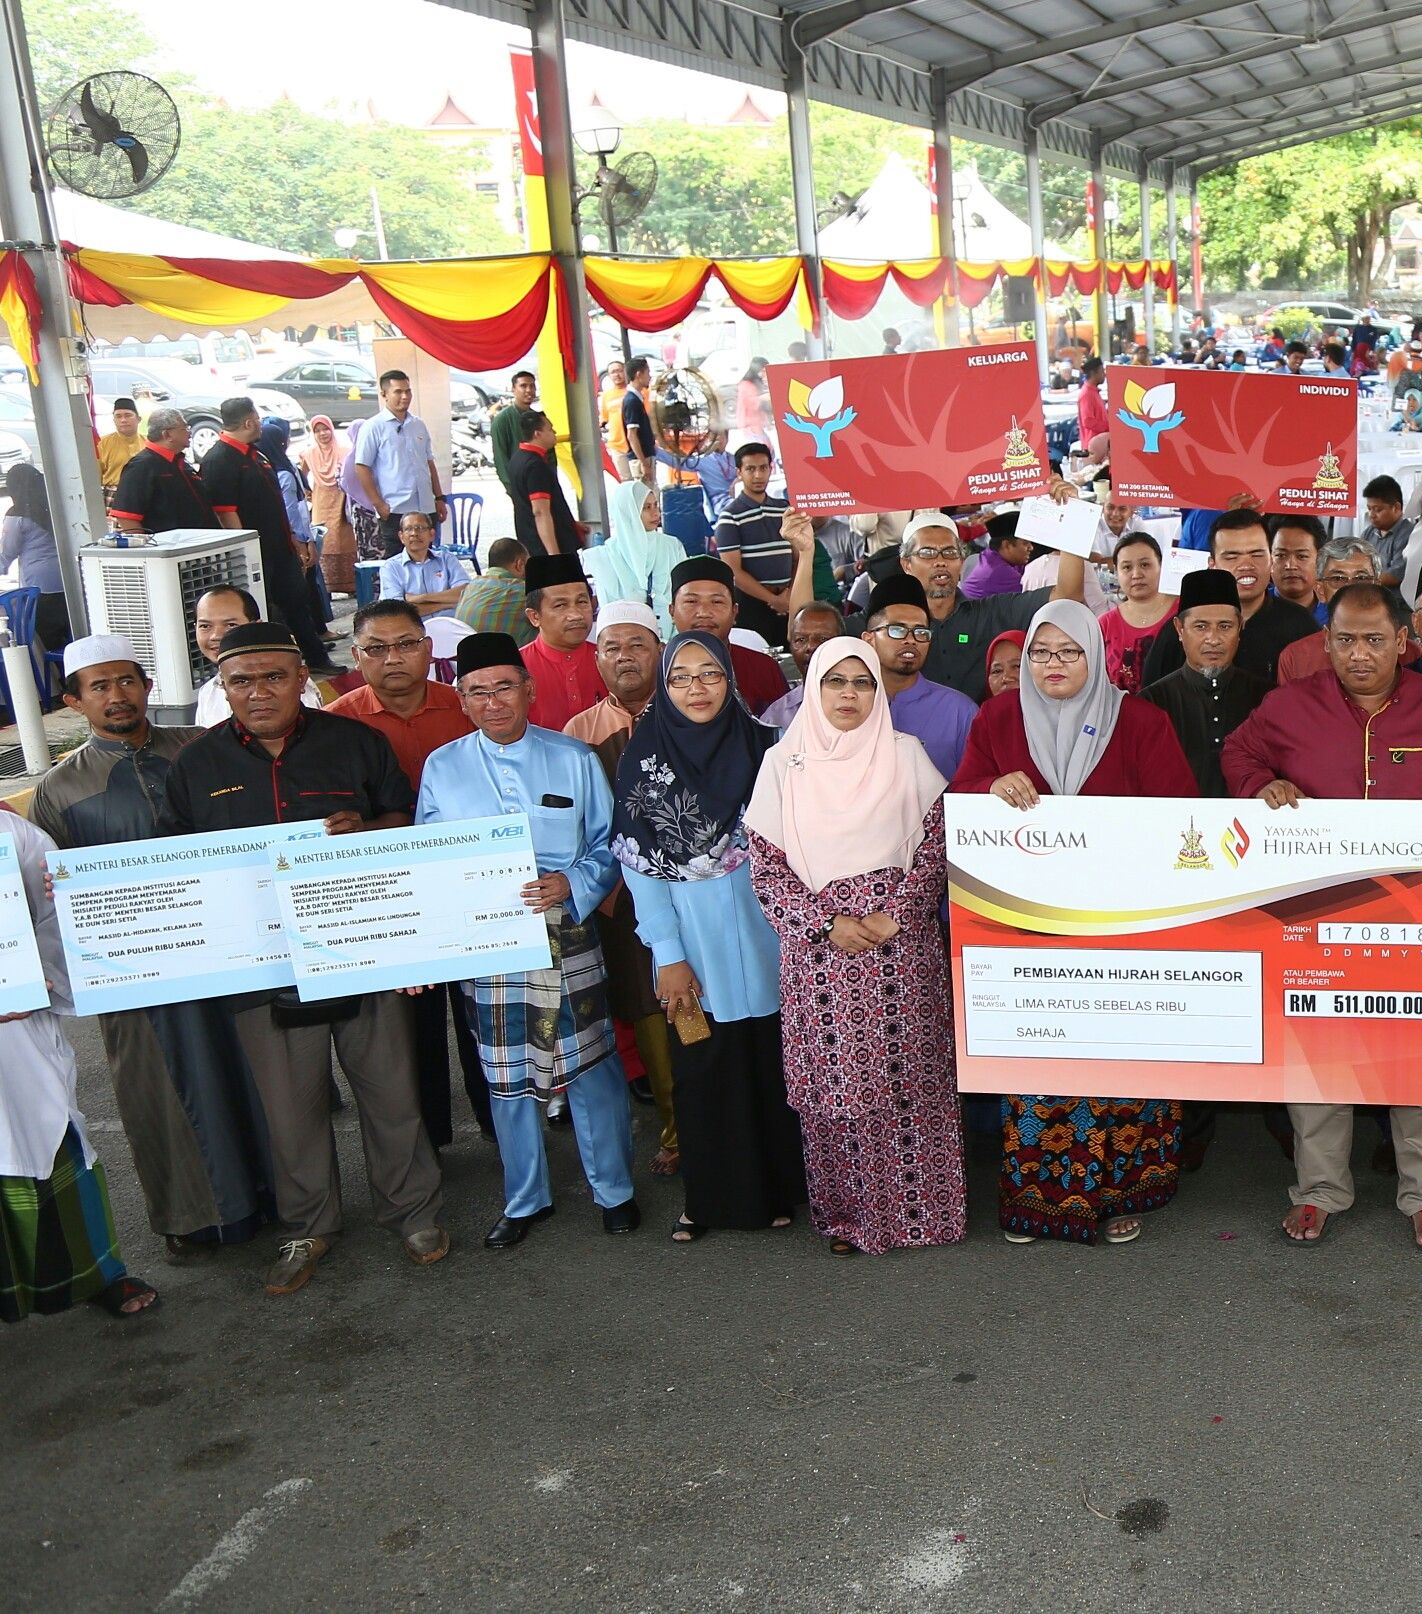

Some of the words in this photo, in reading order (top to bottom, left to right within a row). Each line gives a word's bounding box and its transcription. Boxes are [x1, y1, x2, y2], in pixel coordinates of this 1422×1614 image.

[968, 352, 1028, 367] KELUARGA
[1300, 385, 1349, 396] INDIVIDU
[968, 473, 1008, 485] PEDULI
[1011, 468, 1041, 480] SIHAT
[970, 486, 996, 495] Hanya
[999, 484, 1008, 492] di
[1010, 480, 1044, 491] Selangor
[1279, 489, 1316, 499] PEDULI
[1318, 491, 1349, 501] SIHAT
[1279, 498, 1305, 508] Hanya
[1307, 499, 1315, 508] di
[1317, 500, 1349, 511] Selangor
[956, 829, 1014, 847] BANK
[1026, 831, 1088, 849] ISLAM
[294, 851, 334, 865] MENTERI
[336, 848, 362, 860] BESAR
[363, 842, 410, 857] SELANGOR
[411, 834, 481, 850] PEMERBADANAN
[1264, 839, 1331, 858] HIJRAH
[75, 859, 118, 874] MENTERI
[121, 855, 149, 868] BESAR
[151, 849, 200, 865] SELANGOR
[70, 890, 114, 900] SUMBANGAN
[115, 886, 142, 895] KEPADA
[143, 883, 175, 891] INSTITUSI
[177, 879, 200, 887] AGAMA
[290, 881, 331, 890] SUMBANGAN
[357, 874, 387, 882] INSTITUSI
[292, 889, 321, 898] SEMPENA
[322, 885, 354, 894] PROGRAM
[355, 879, 398, 889] MENYEMARAK
[293, 896, 321, 904] INISIATIF
[322, 893, 344, 901] PEDULI
[345, 890, 369, 898] RAKYAT
[381, 891, 413, 900] SELANGOR
[490, 910, 524, 920] 20,000.00
[98, 933, 122, 941] MASJID
[163, 924, 188, 932] KELANA
[327, 938, 344, 946] DUA
[345, 936, 369, 944] PULUH
[370, 933, 388, 941] RIBU
[389, 929, 418, 938] SAHAJA
[108, 950, 126, 958] DUA
[127, 945, 154, 955] PULUH
[155, 943, 174, 952] RIBU
[176, 939, 206, 949] SAHAJA
[1013, 967, 1104, 980] PEMBIAYAAN
[1108, 968, 1159, 981] HIJRAH
[1164, 970, 1244, 982] SELANGOR
[1015, 998, 1045, 1009] LIMA
[1048, 999, 1090, 1010] RATUS
[1094, 1000, 1152, 1011] SEBELAS
[1156, 1001, 1187, 1012] RIBU
[1290, 994, 1316, 1013] RM
[1016, 1027, 1066, 1038] SAHAJA
